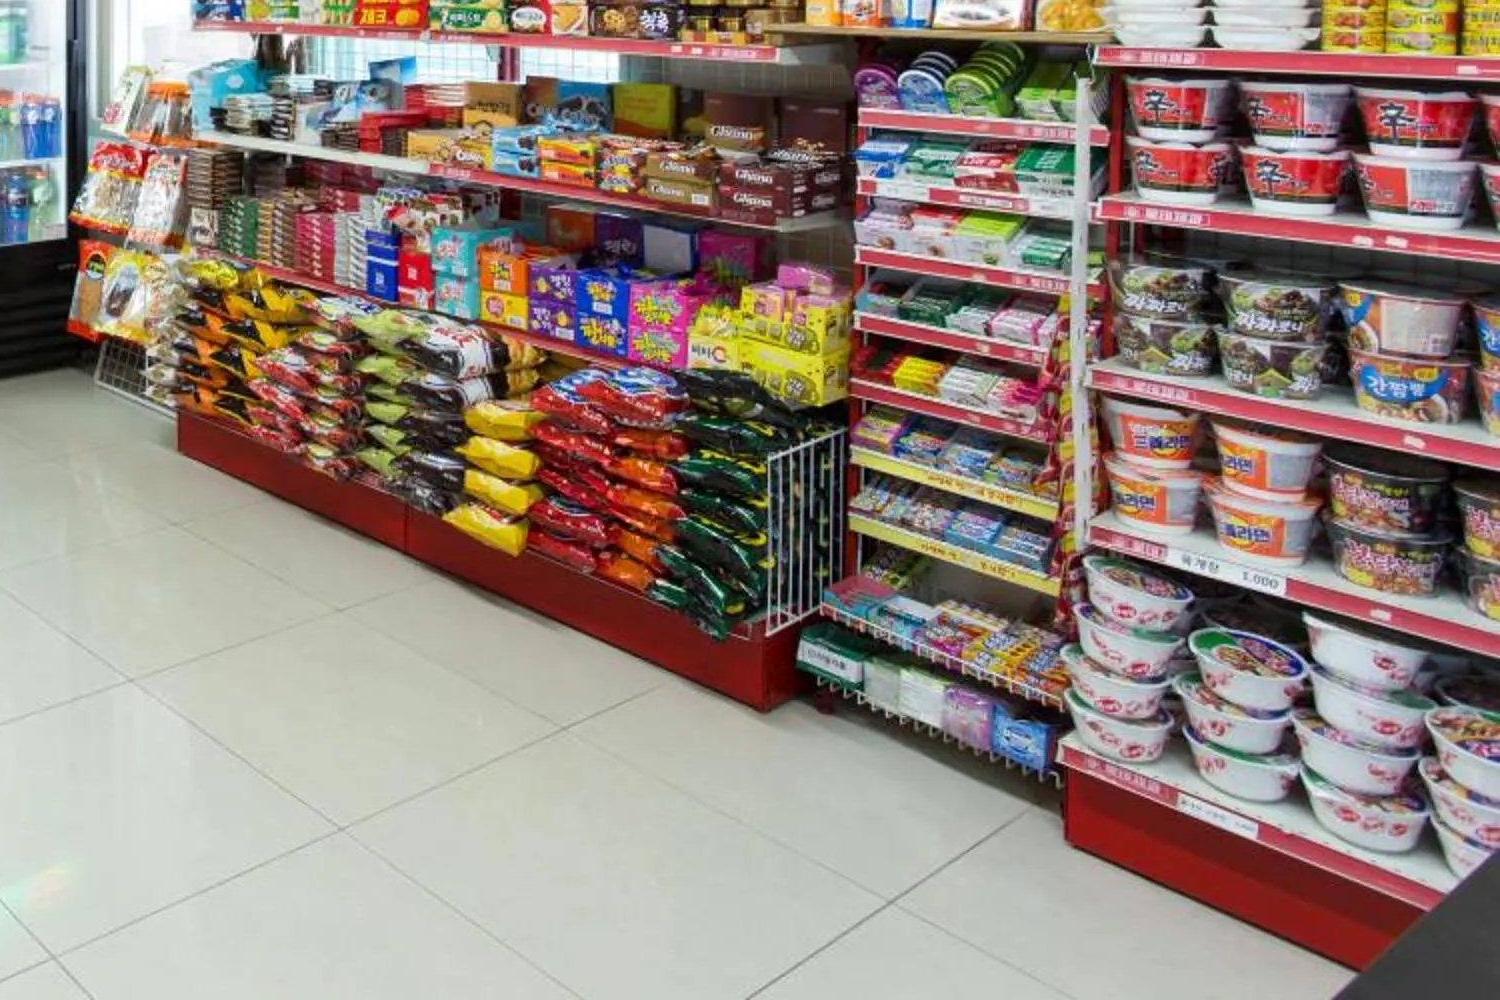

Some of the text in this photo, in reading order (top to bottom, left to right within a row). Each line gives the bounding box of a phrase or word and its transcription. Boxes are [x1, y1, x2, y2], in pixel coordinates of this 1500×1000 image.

[710, 124, 754, 141] Ghana
[735, 169, 773, 185] Ghana
[733, 192, 773, 207] Ghana
